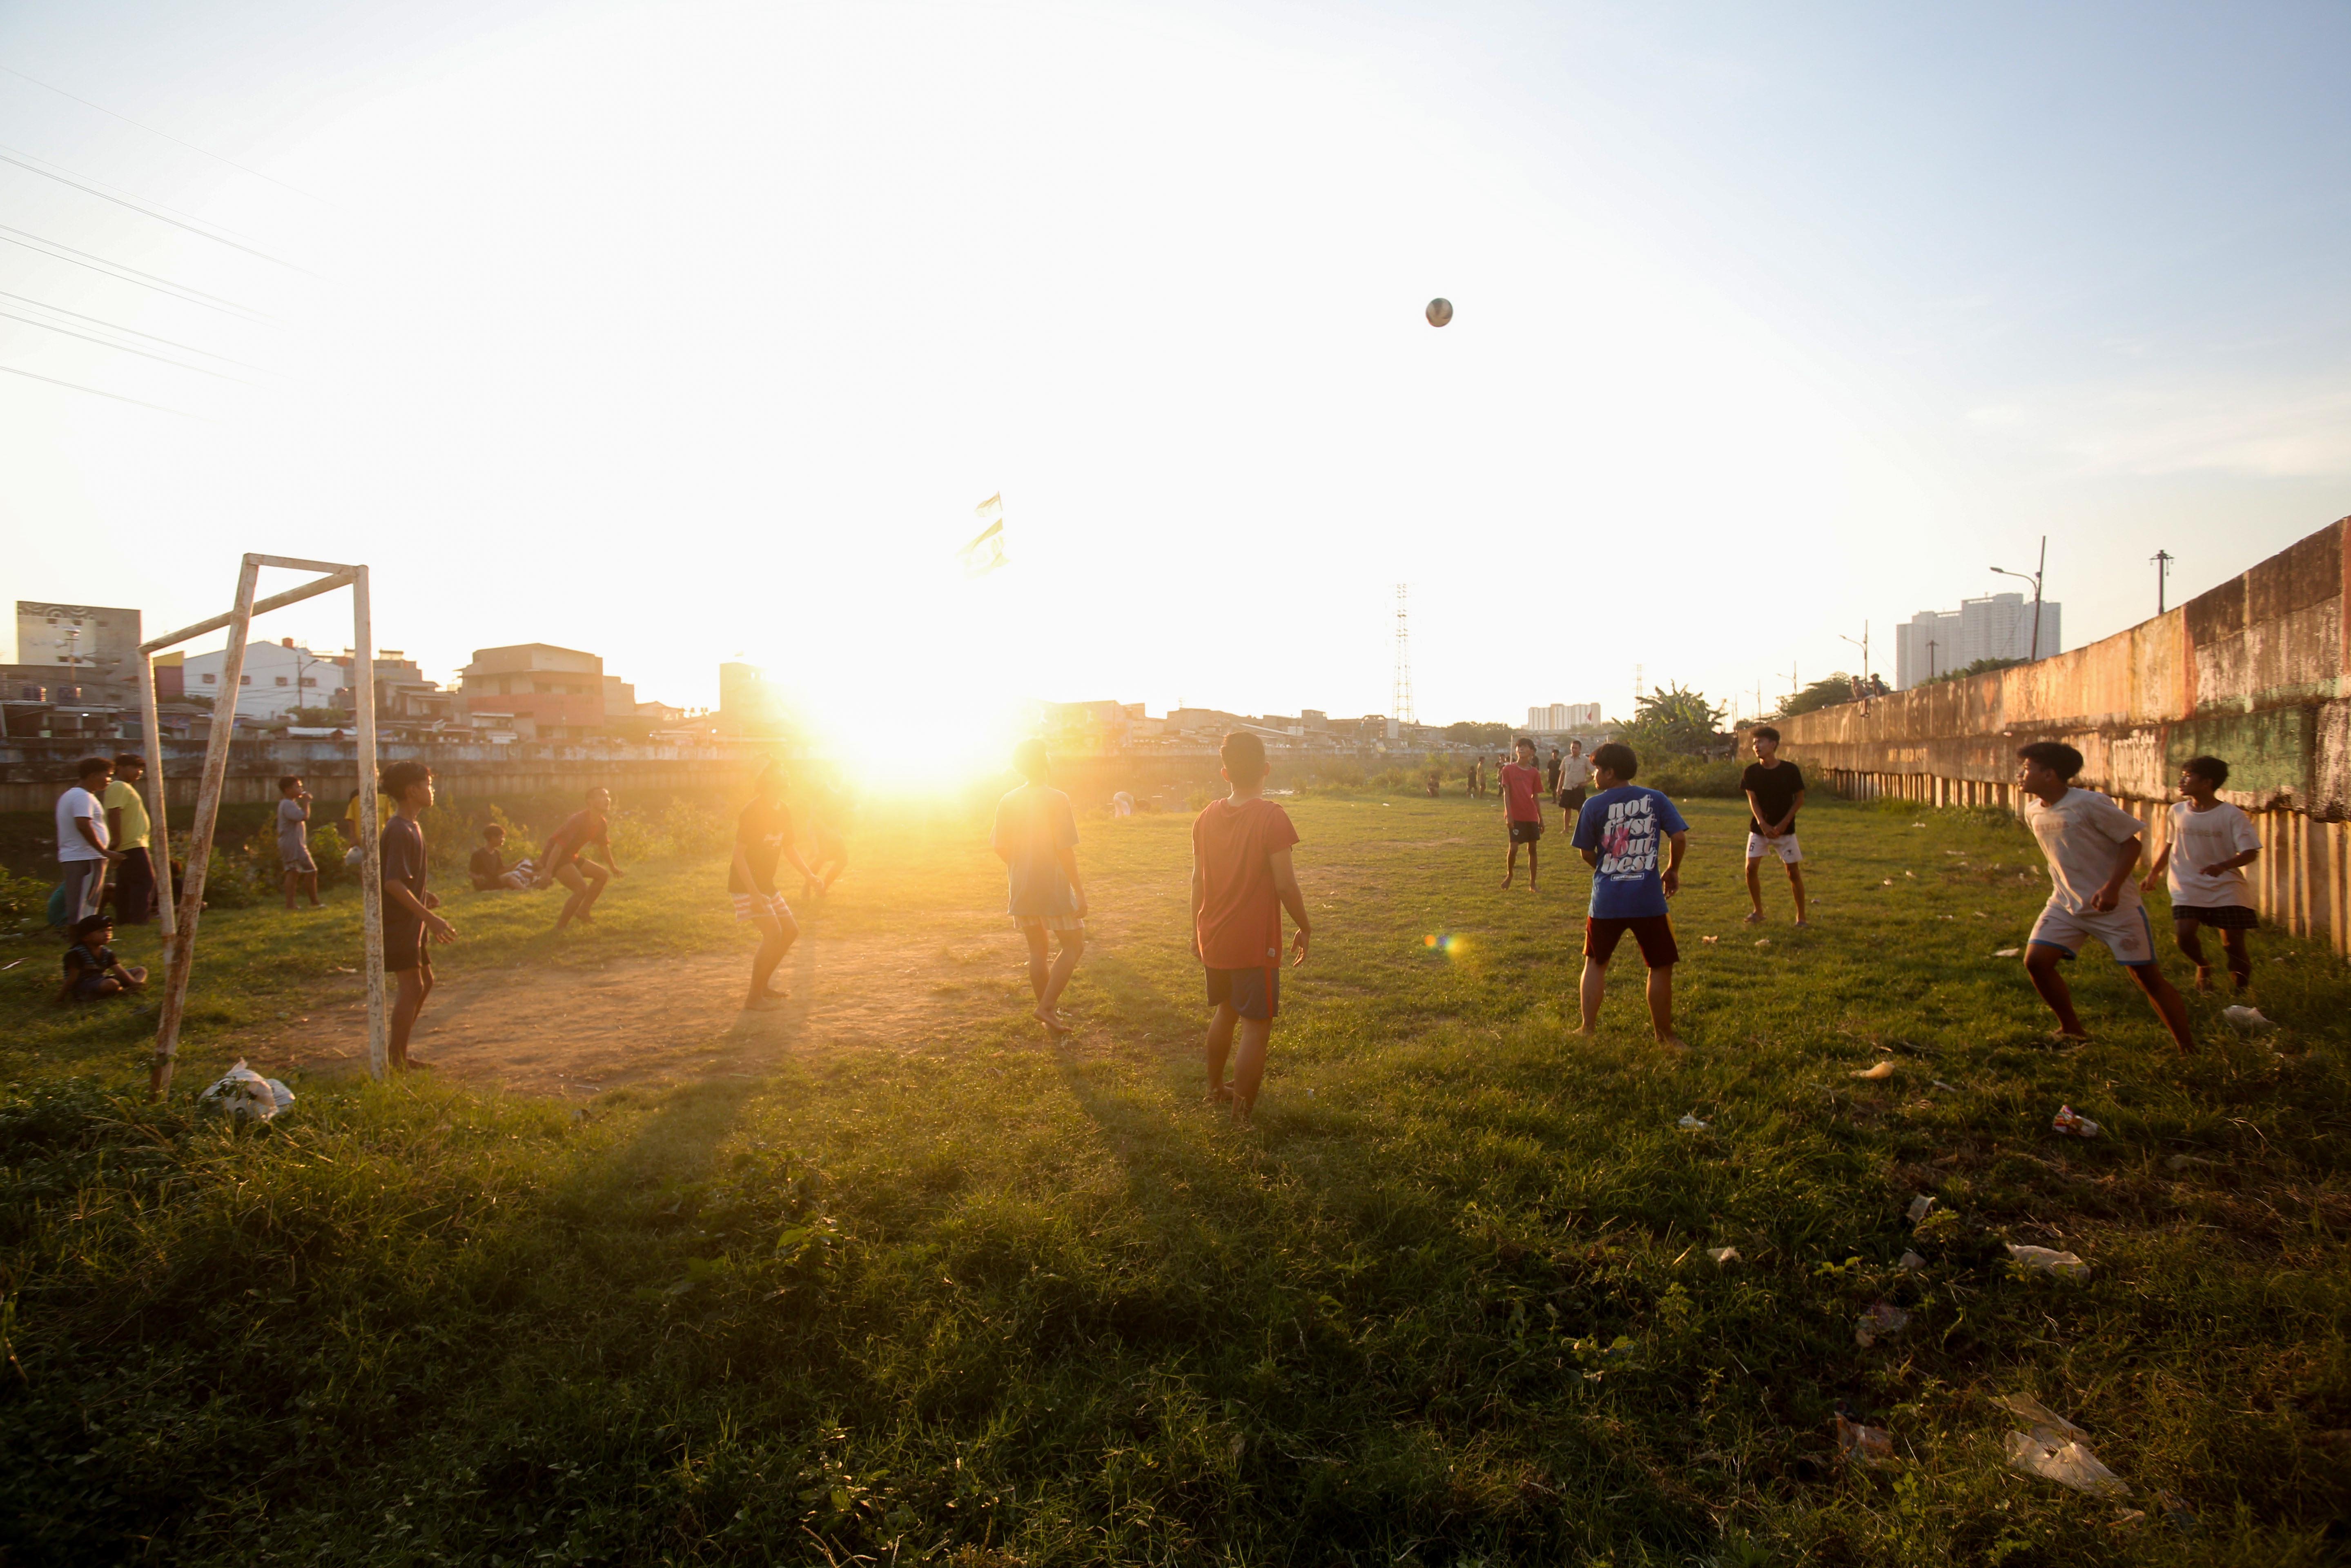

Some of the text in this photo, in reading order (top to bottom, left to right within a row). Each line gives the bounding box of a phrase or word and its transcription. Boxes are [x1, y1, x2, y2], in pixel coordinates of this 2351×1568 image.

[1608, 794, 1653, 820] not
[1603, 813, 1657, 837] first
[1613, 834, 1657, 858] but
[1601, 847, 1657, 874] best
